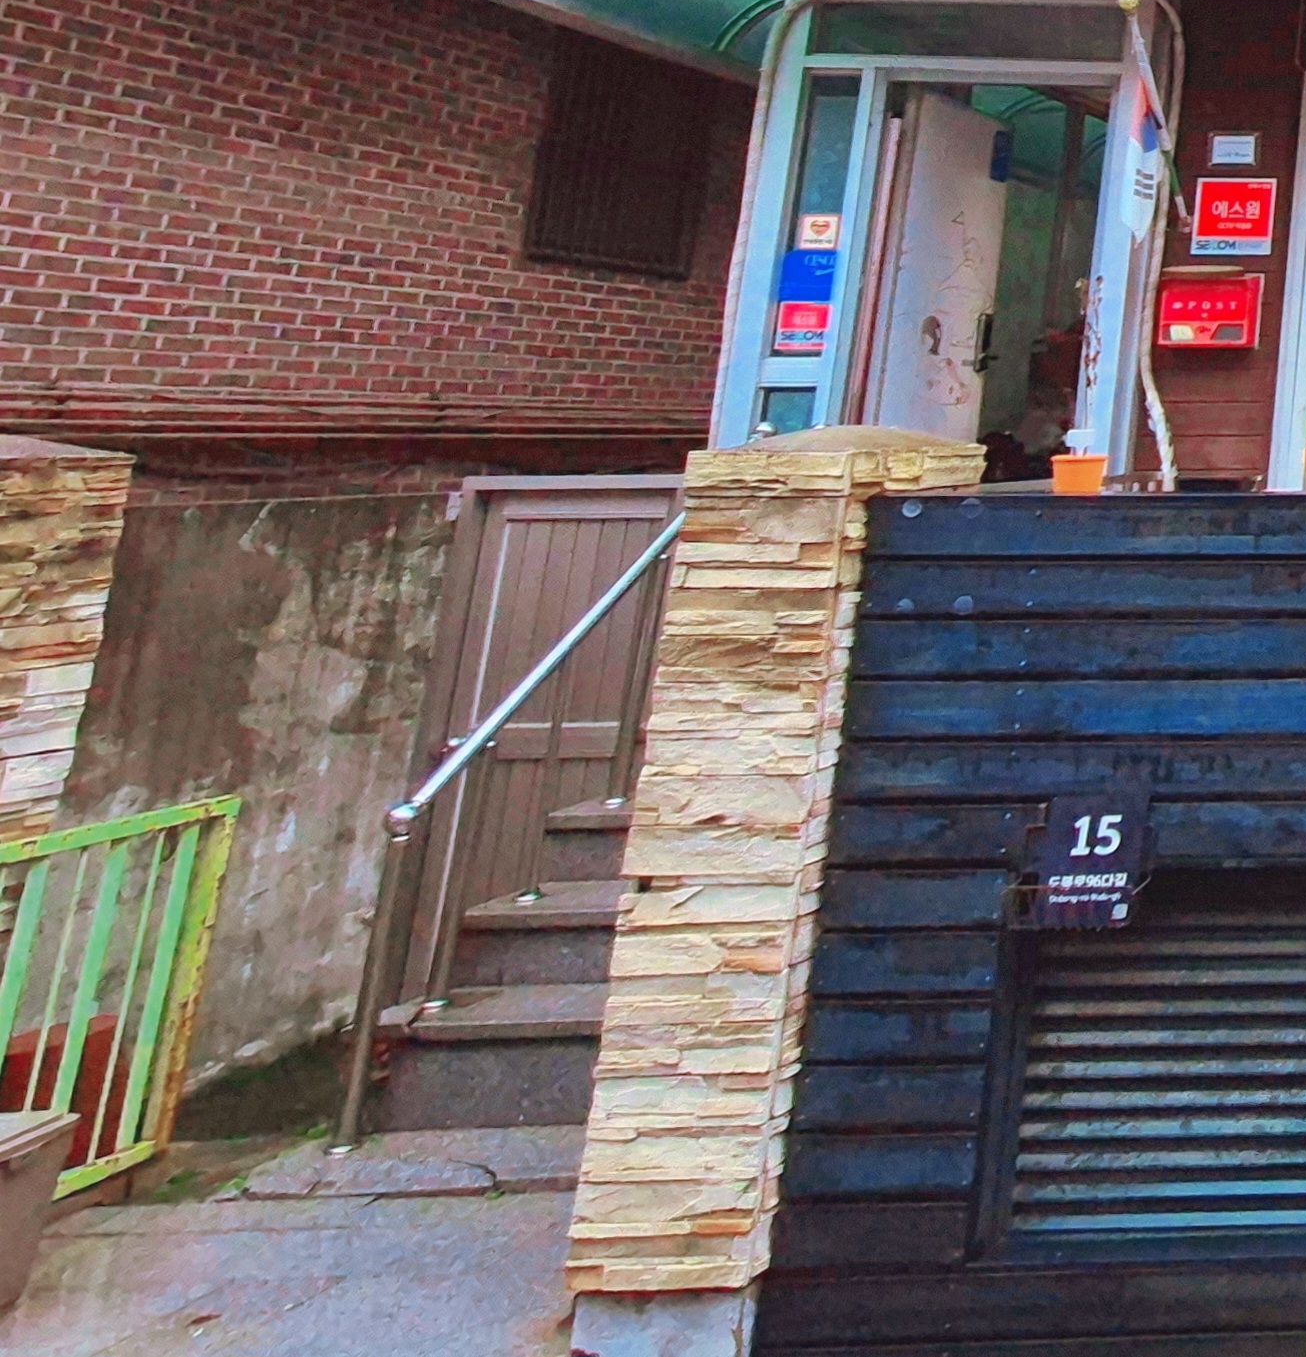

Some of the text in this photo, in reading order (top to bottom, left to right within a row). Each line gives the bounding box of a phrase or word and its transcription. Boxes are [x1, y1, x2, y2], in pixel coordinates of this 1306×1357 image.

[1211, 200, 1261, 220] 에스원
[1187, 300, 1238, 311] POST
[1069, 813, 1123, 857] 15
